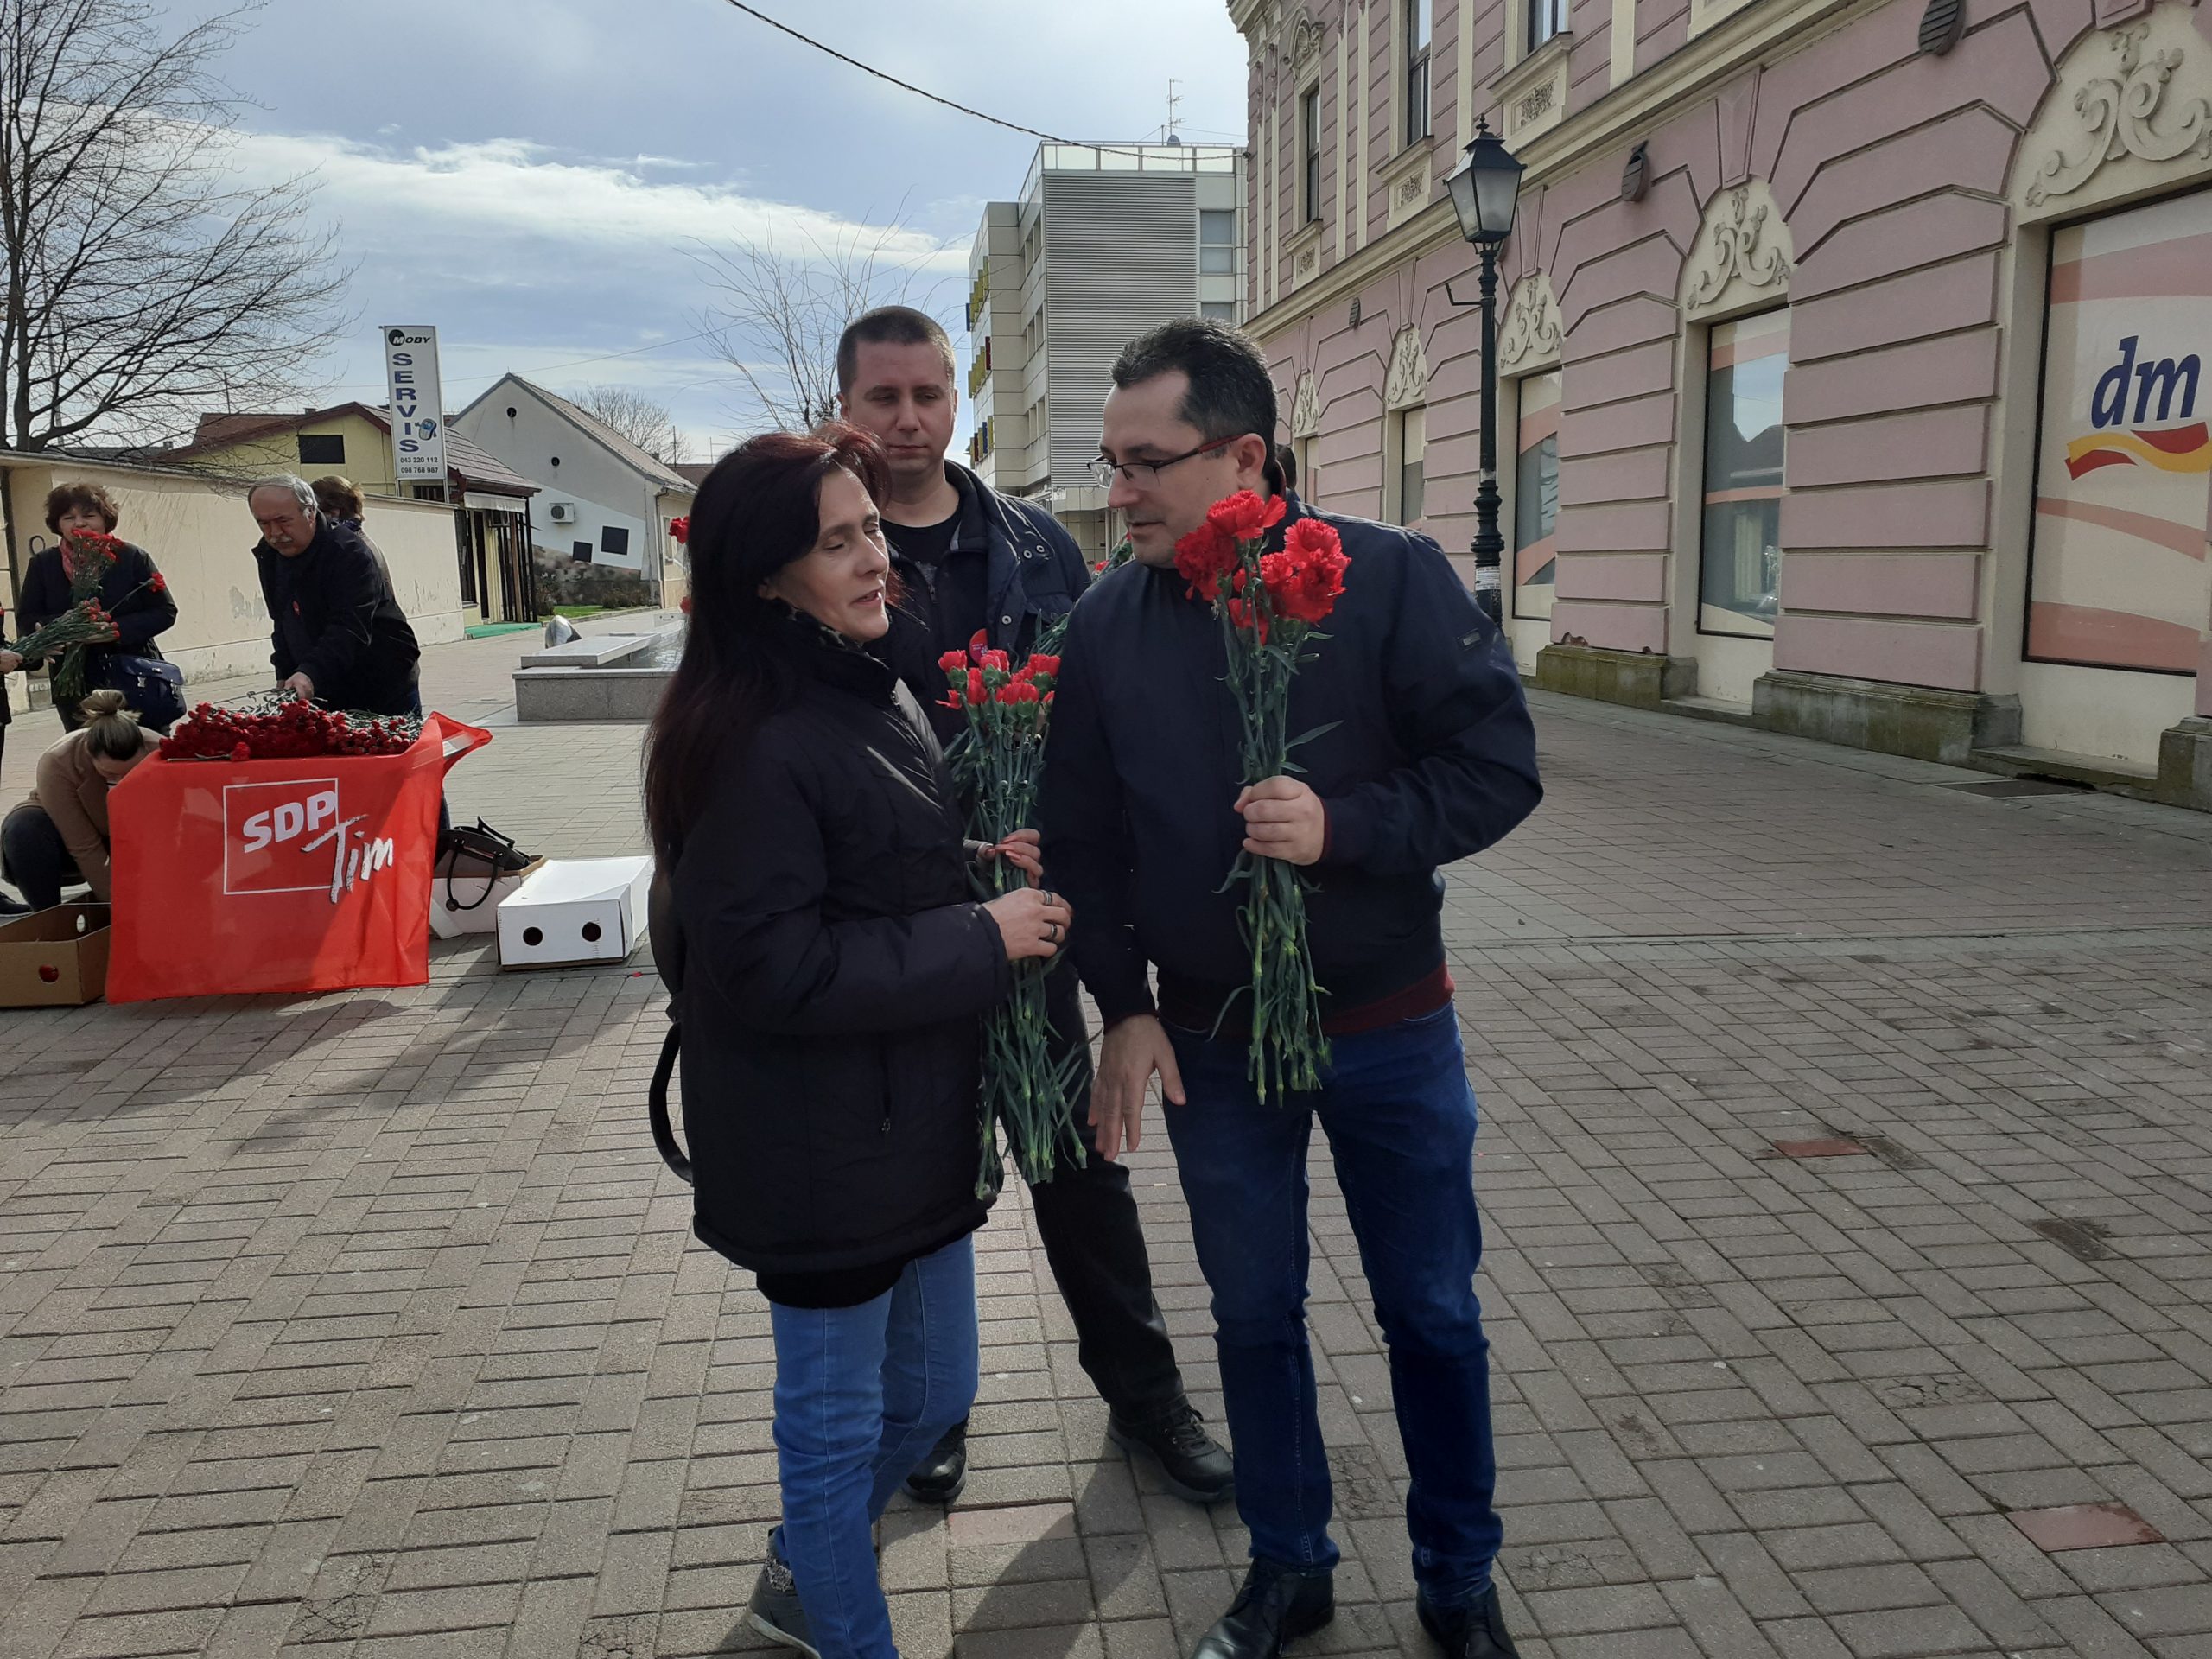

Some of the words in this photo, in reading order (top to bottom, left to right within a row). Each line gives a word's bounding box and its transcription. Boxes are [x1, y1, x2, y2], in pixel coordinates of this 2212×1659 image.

[391, 335, 431, 345] MOBY
[2091, 335, 2201, 429] dm
[392, 353, 420, 453] SERVIS
[243, 791, 337, 853] SDP
[301, 814, 393, 904] Tim
